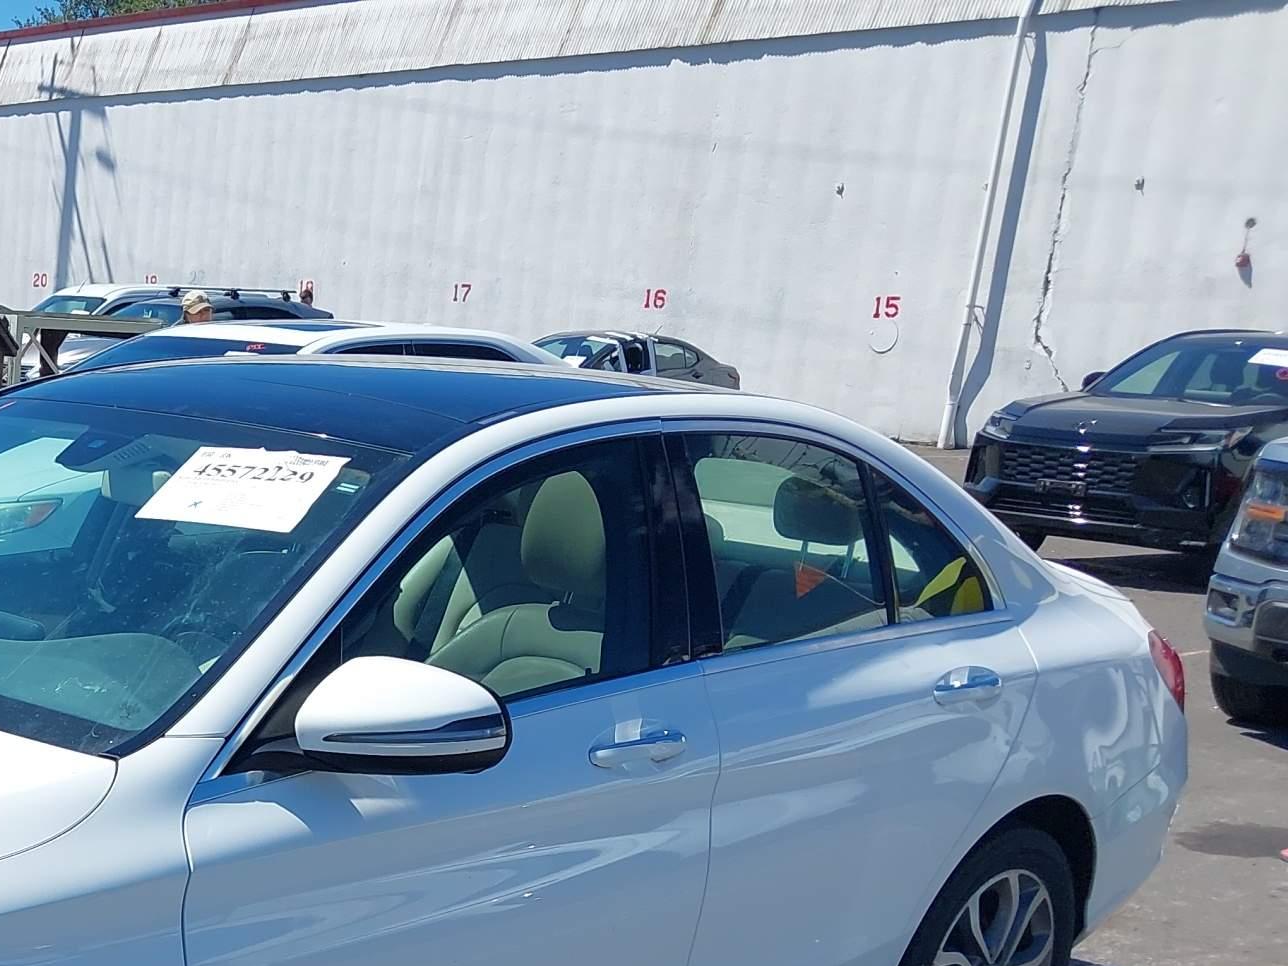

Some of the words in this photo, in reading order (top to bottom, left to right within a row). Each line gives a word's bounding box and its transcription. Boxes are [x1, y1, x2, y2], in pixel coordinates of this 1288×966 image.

[32, 272, 48, 288] 20
[452, 283, 472, 302] 17
[644, 288, 667, 309] 16
[872, 296, 901, 319] 15
[193, 463, 315, 483] 45572229
